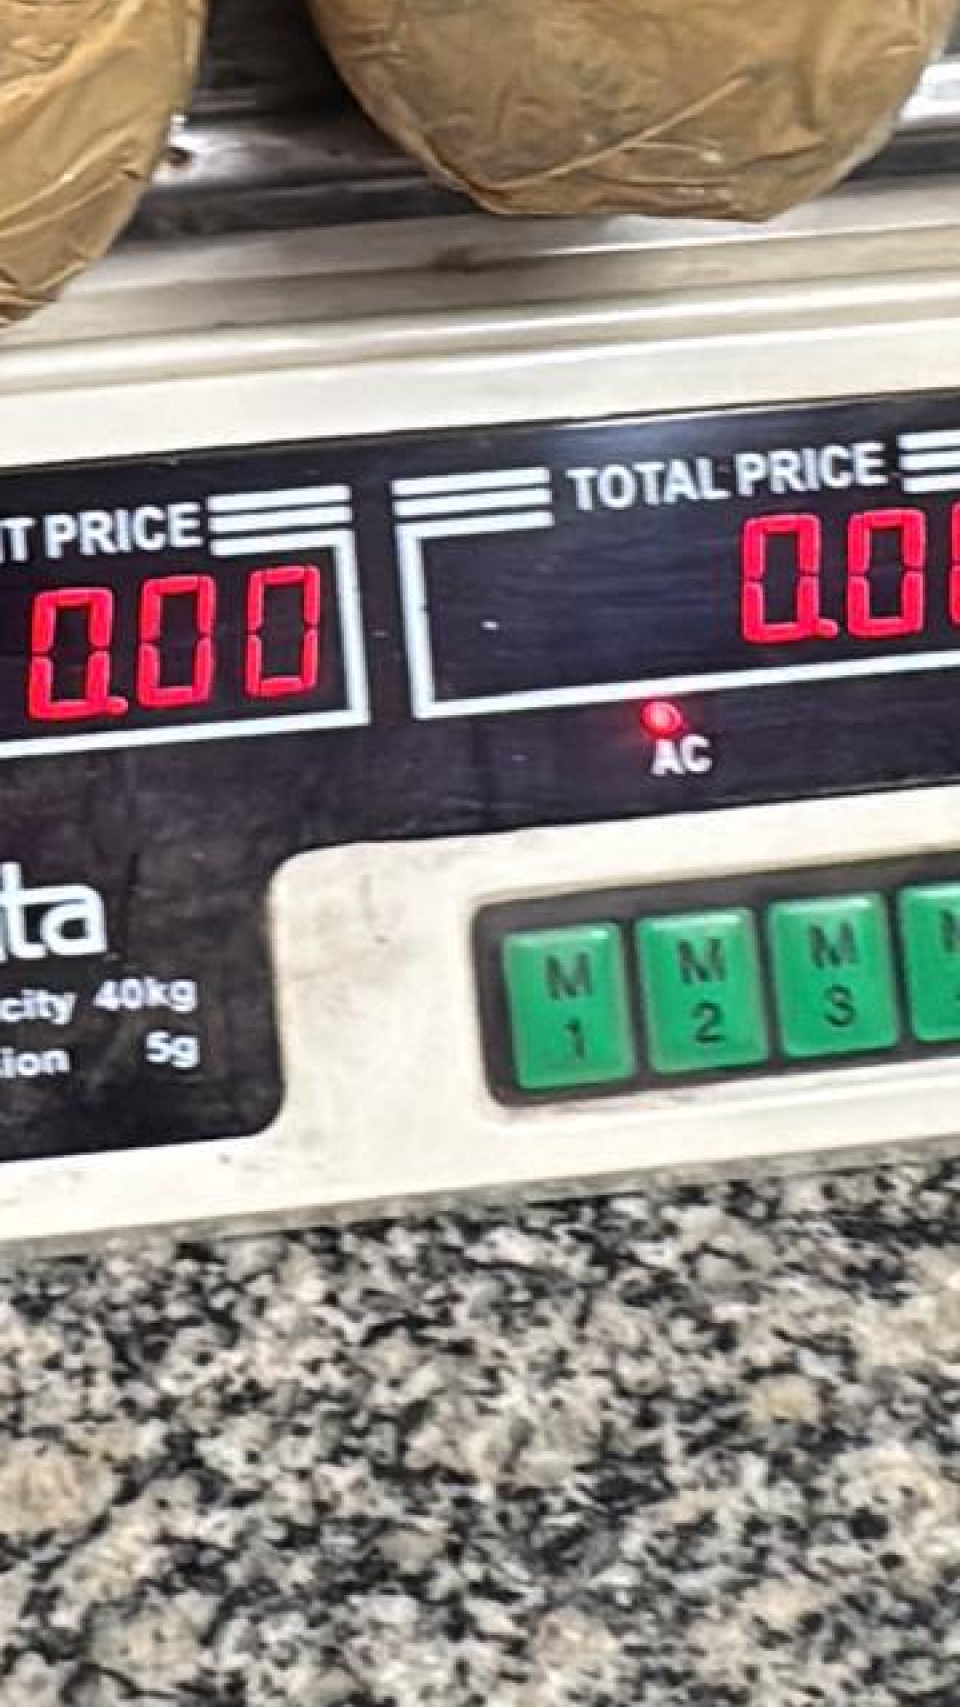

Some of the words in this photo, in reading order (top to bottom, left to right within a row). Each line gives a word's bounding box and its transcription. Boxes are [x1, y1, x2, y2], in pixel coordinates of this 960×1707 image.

[566, 457, 732, 511] TOTAL
[734, 441, 888, 495] PRICE
[45, 502, 203, 559] PRICE
[742, 501, 960, 644] 0.0
[27, 565, 322, 720] 0.00
[650, 734, 714, 777] AC
[675, 937, 727, 985] M
[807, 918, 859, 969] M
[92, 977, 199, 1014] 40kg
[544, 951, 594, 1001] M
[690, 999, 726, 1045] 2
[822, 984, 857, 1028] 3
[144, 1029, 201, 1069] 5g
[563, 1018, 586, 1059] 1
